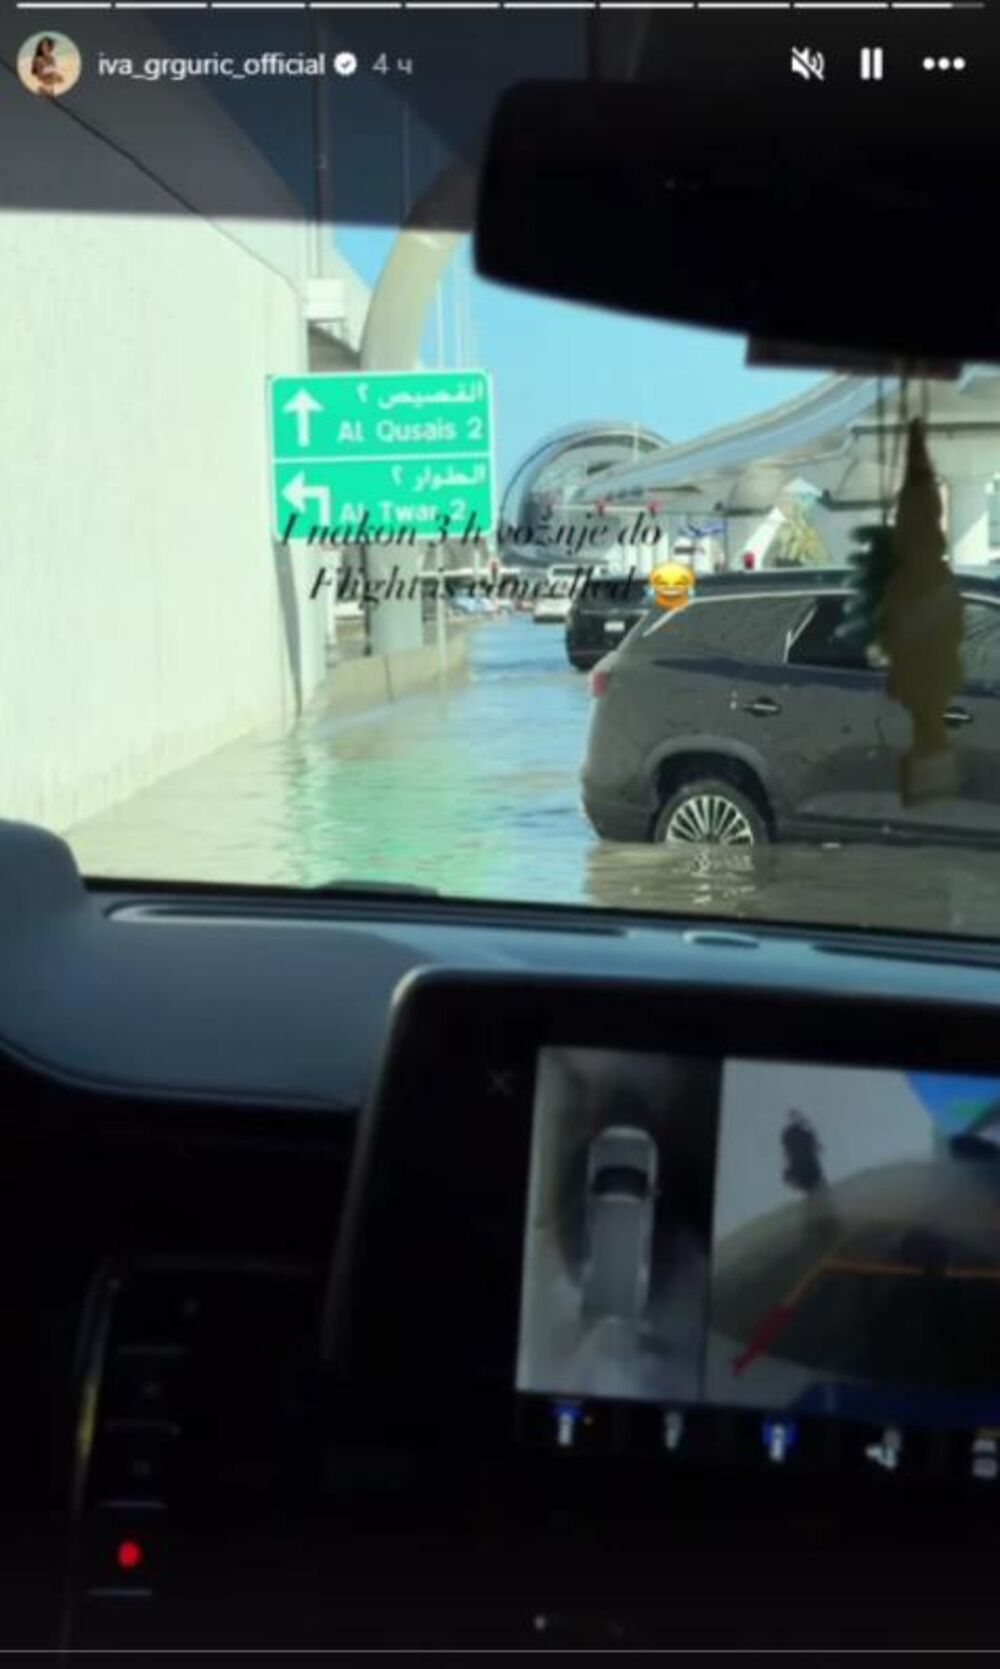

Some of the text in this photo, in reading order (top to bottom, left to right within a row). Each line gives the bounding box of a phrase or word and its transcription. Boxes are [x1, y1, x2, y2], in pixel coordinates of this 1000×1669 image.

[377, 380, 484, 410] القصيص
[336, 415, 483, 443] Al Qusais 2
[339, 498, 466, 524] Al Twar 2
